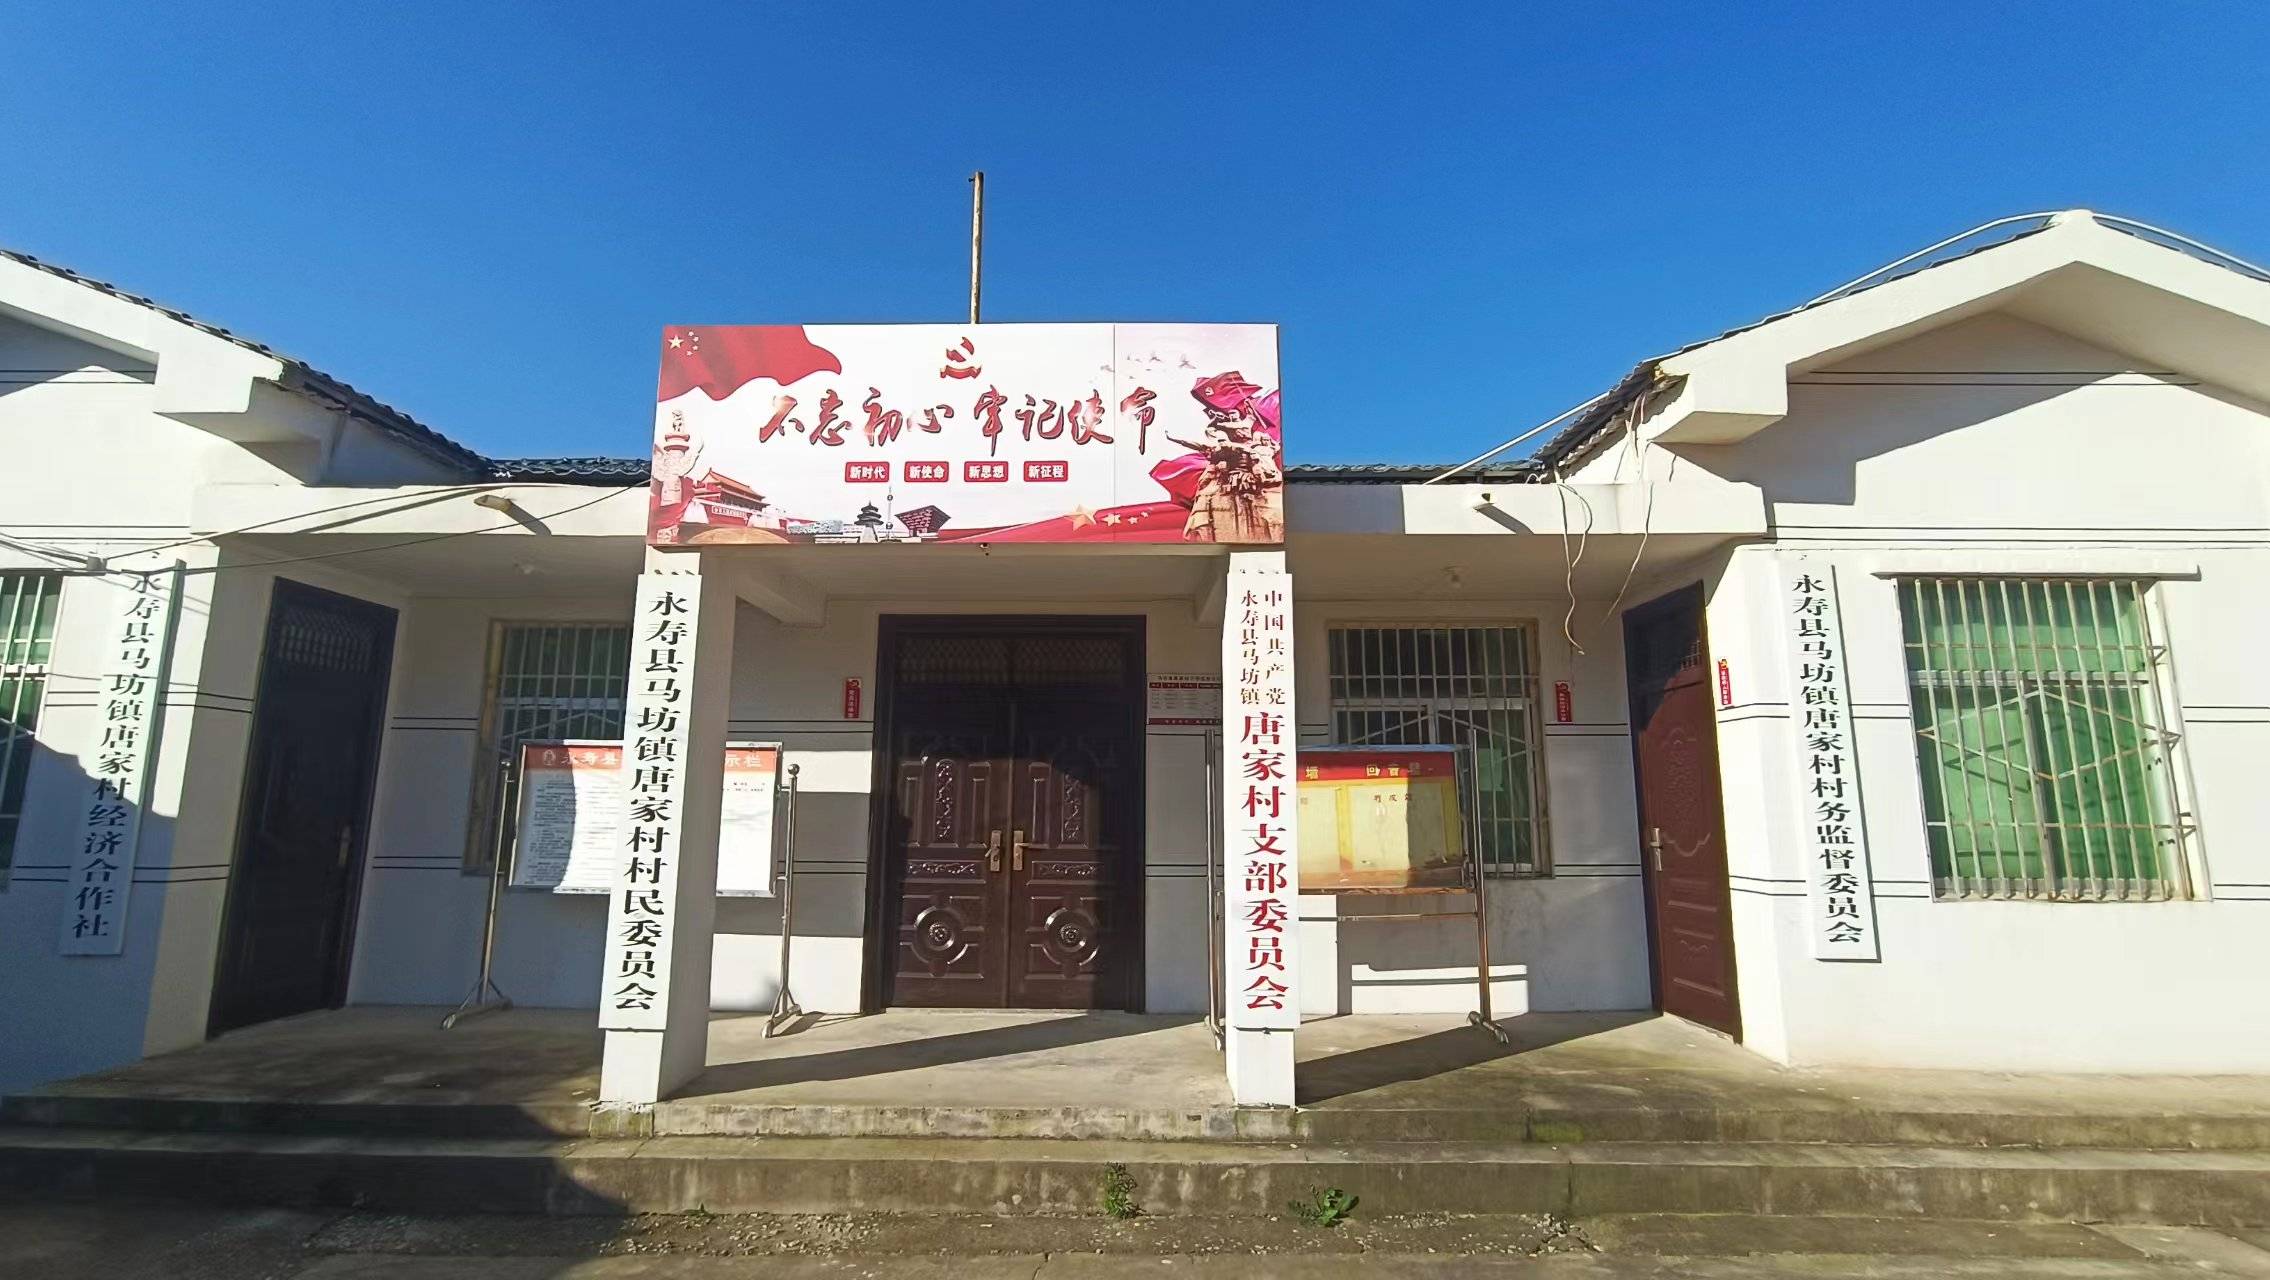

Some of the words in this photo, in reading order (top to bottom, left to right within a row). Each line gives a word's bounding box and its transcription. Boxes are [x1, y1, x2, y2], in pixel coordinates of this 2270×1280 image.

[759, 386, 955, 449] 不忘初心
[972, 384, 1157, 457] 牢记使命
[850, 465, 887, 480] 新时代
[909, 465, 946, 480] 新使命
[968, 465, 1005, 480] 新思想
[1028, 465, 1065, 480] 新征程
[1240, 589, 1261, 706] 永寿县马坊镇
[1264, 589, 1285, 706] 中国共产党
[73, 573, 162, 939] 永寿县马坊镇唐家村经济合作社
[613, 591, 689, 1010] 永寿县马坊镇唐家村村民委员会
[1791, 573, 1865, 944] 永寿县马坊镇唐家村村务监督委员会
[1240, 711, 1290, 1010] 唐家村支部委员会
